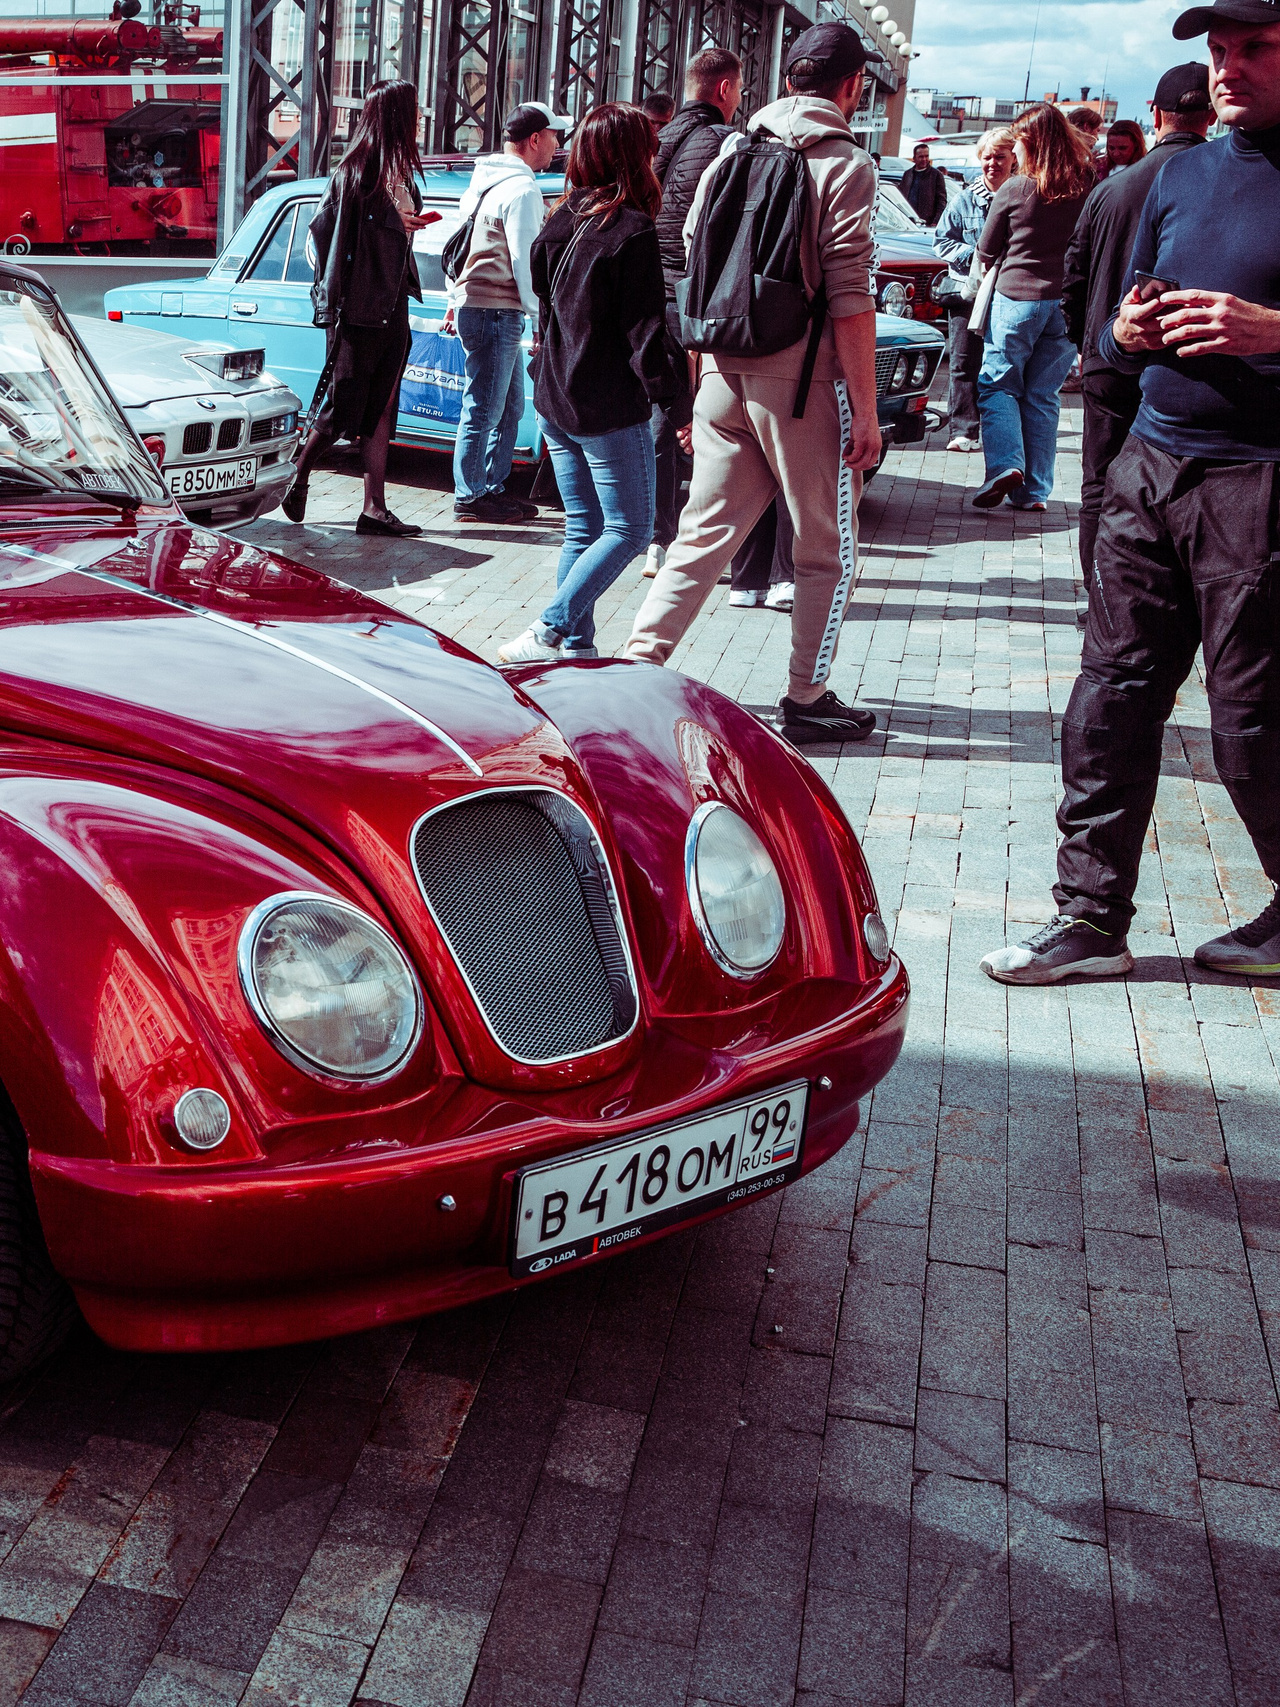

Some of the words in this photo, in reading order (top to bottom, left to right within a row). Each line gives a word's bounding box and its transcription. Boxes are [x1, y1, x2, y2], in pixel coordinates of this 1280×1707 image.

[412, 405, 444, 417] LETU.RU
[238, 460, 252, 479] 59
[80, 473, 126, 490] АВТОВЕК
[237, 478, 247, 486] RUS
[750, 1099, 791, 1153] 99
[740, 1149, 772, 1174] RUS
[727, 1186, 747, 1202] (343)
[747, 1173, 786, 1194] 253-00-53
[598, 1225, 642, 1249] АВТОВЕК
[554, 1249, 577, 1264] LADA
